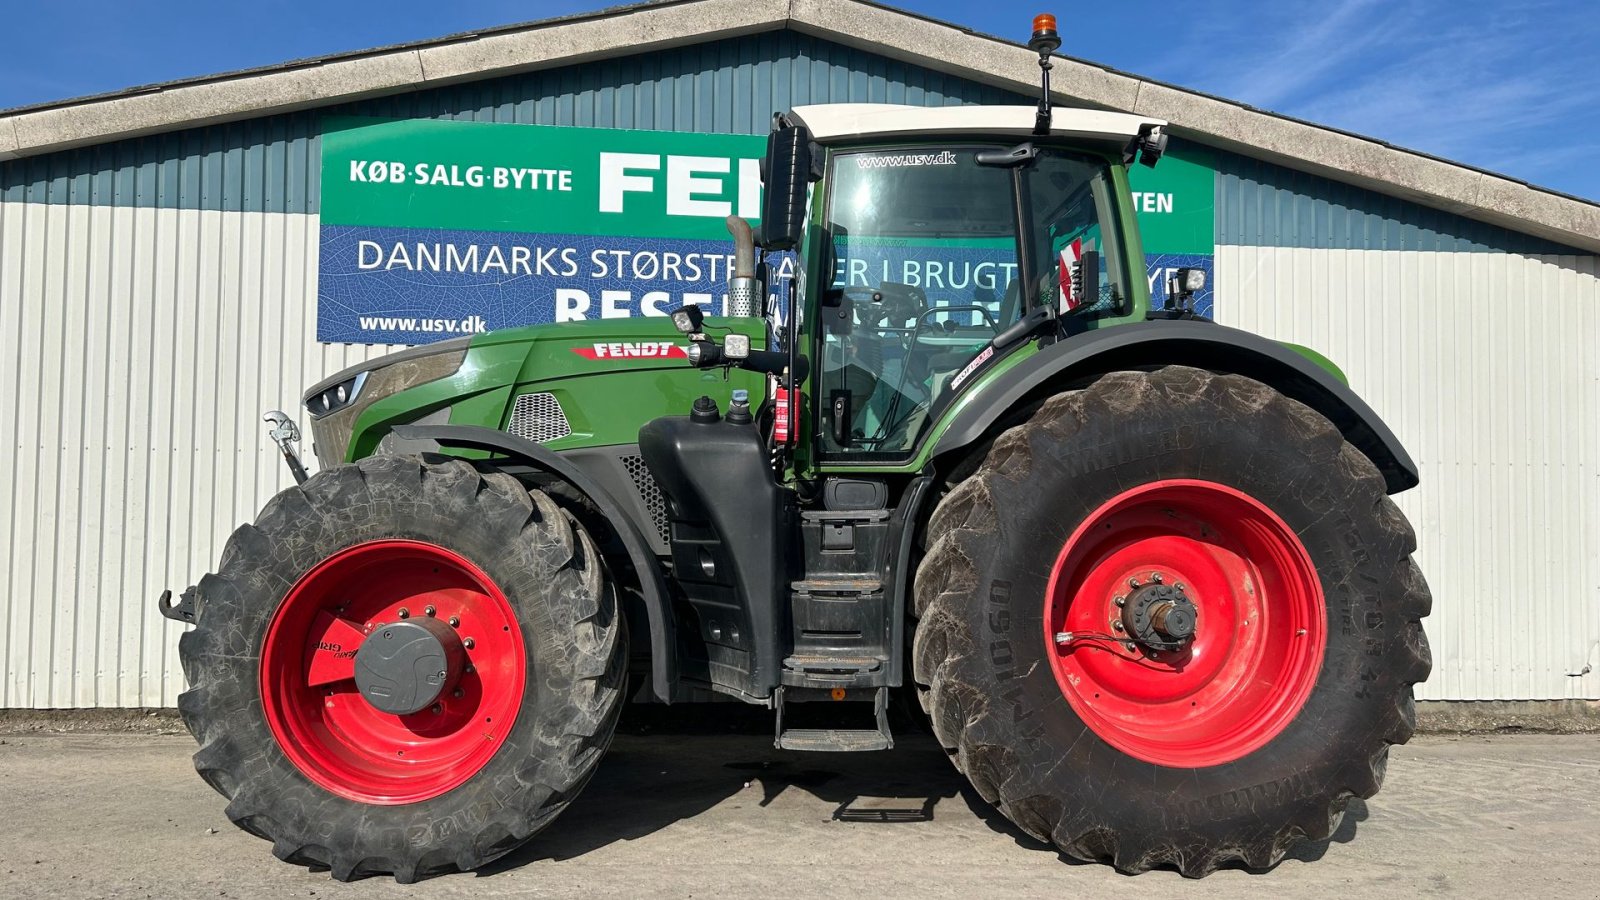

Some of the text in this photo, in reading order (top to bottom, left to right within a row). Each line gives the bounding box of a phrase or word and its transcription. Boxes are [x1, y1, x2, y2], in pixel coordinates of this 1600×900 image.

[856, 151, 957, 168] www.usv.dk
[357, 240, 579, 277] DANMARKS
[359, 316, 486, 334] www.usv.dk
[593, 341, 674, 358] FENDT
